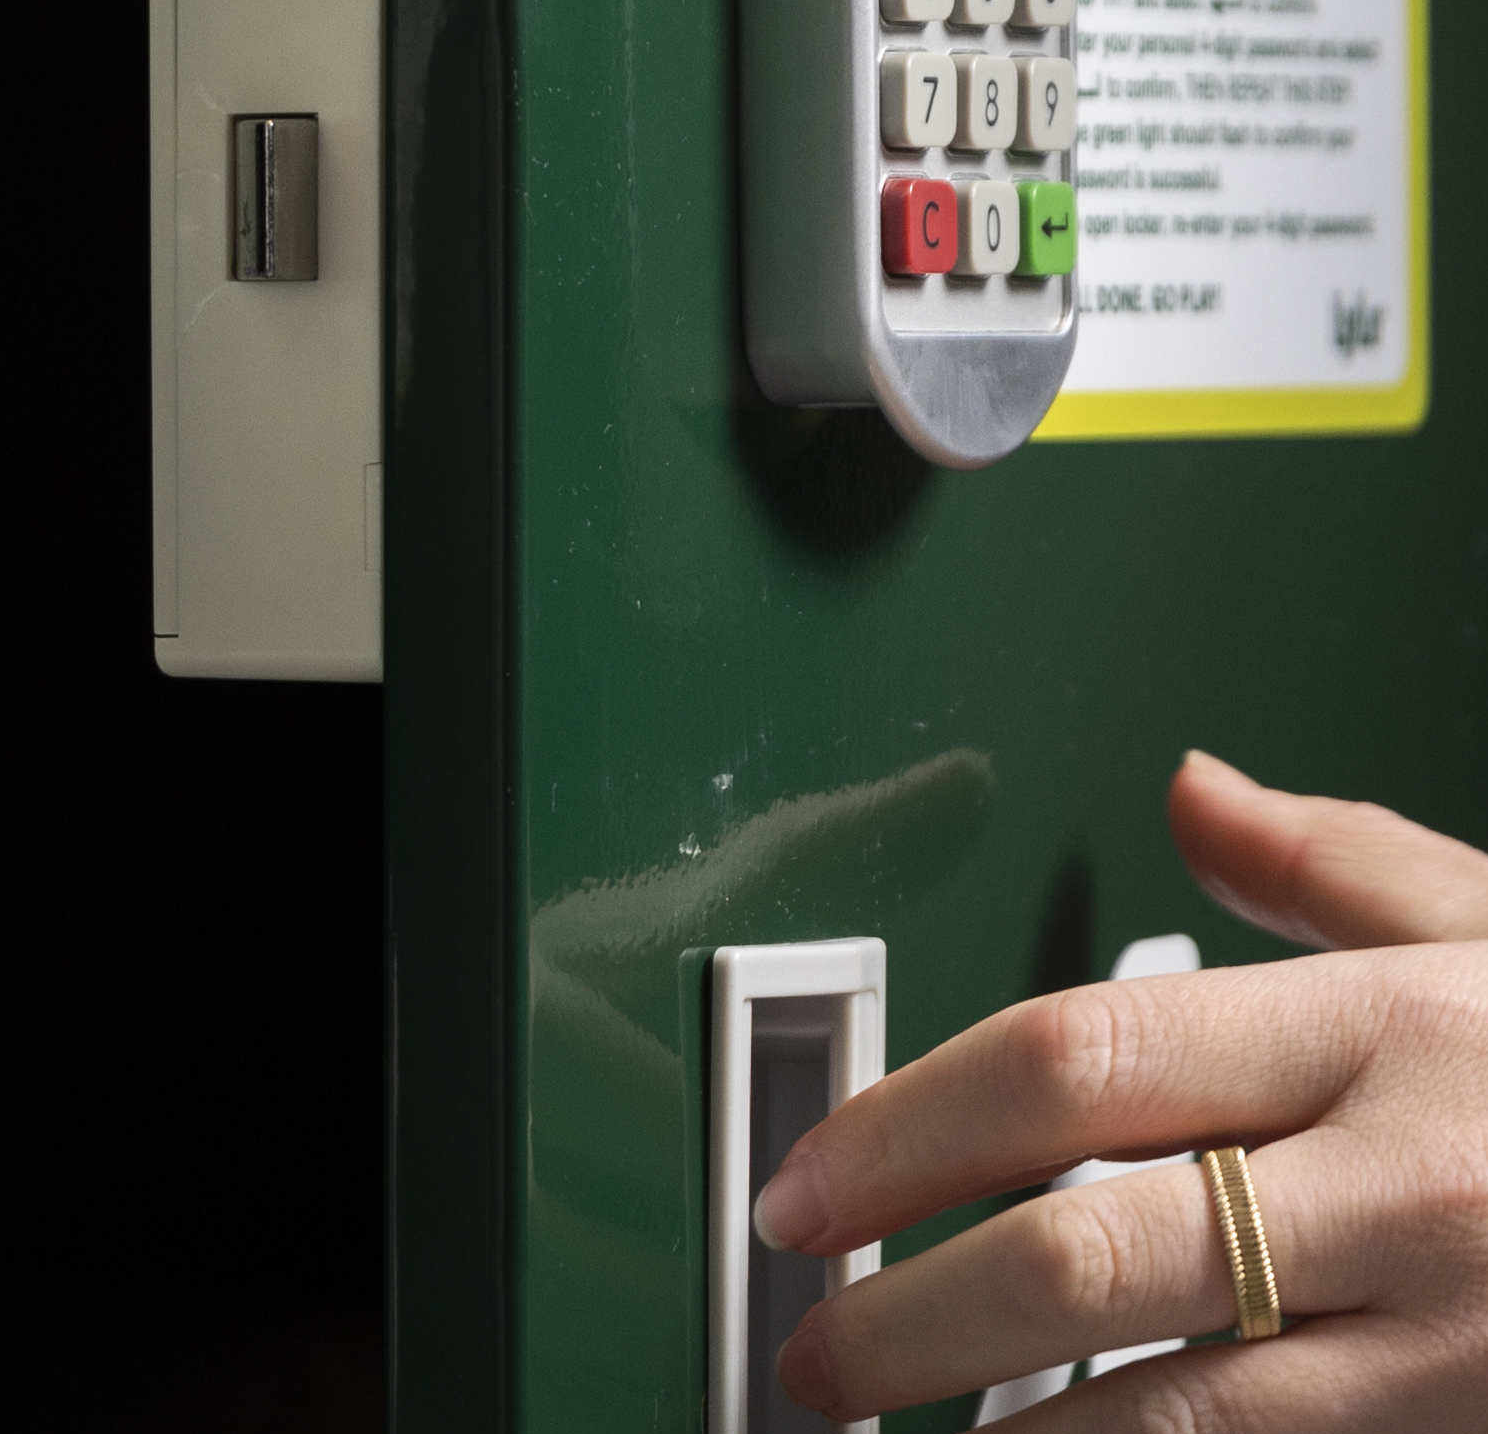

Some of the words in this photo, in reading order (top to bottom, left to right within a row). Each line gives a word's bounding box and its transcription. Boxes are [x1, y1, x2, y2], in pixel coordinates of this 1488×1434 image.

[921, 74, 940, 125] 7
[984, 77, 1000, 129] 8
[1044, 80, 1060, 126] 9
[921, 199, 941, 251] C
[986, 203, 1002, 254] 0
